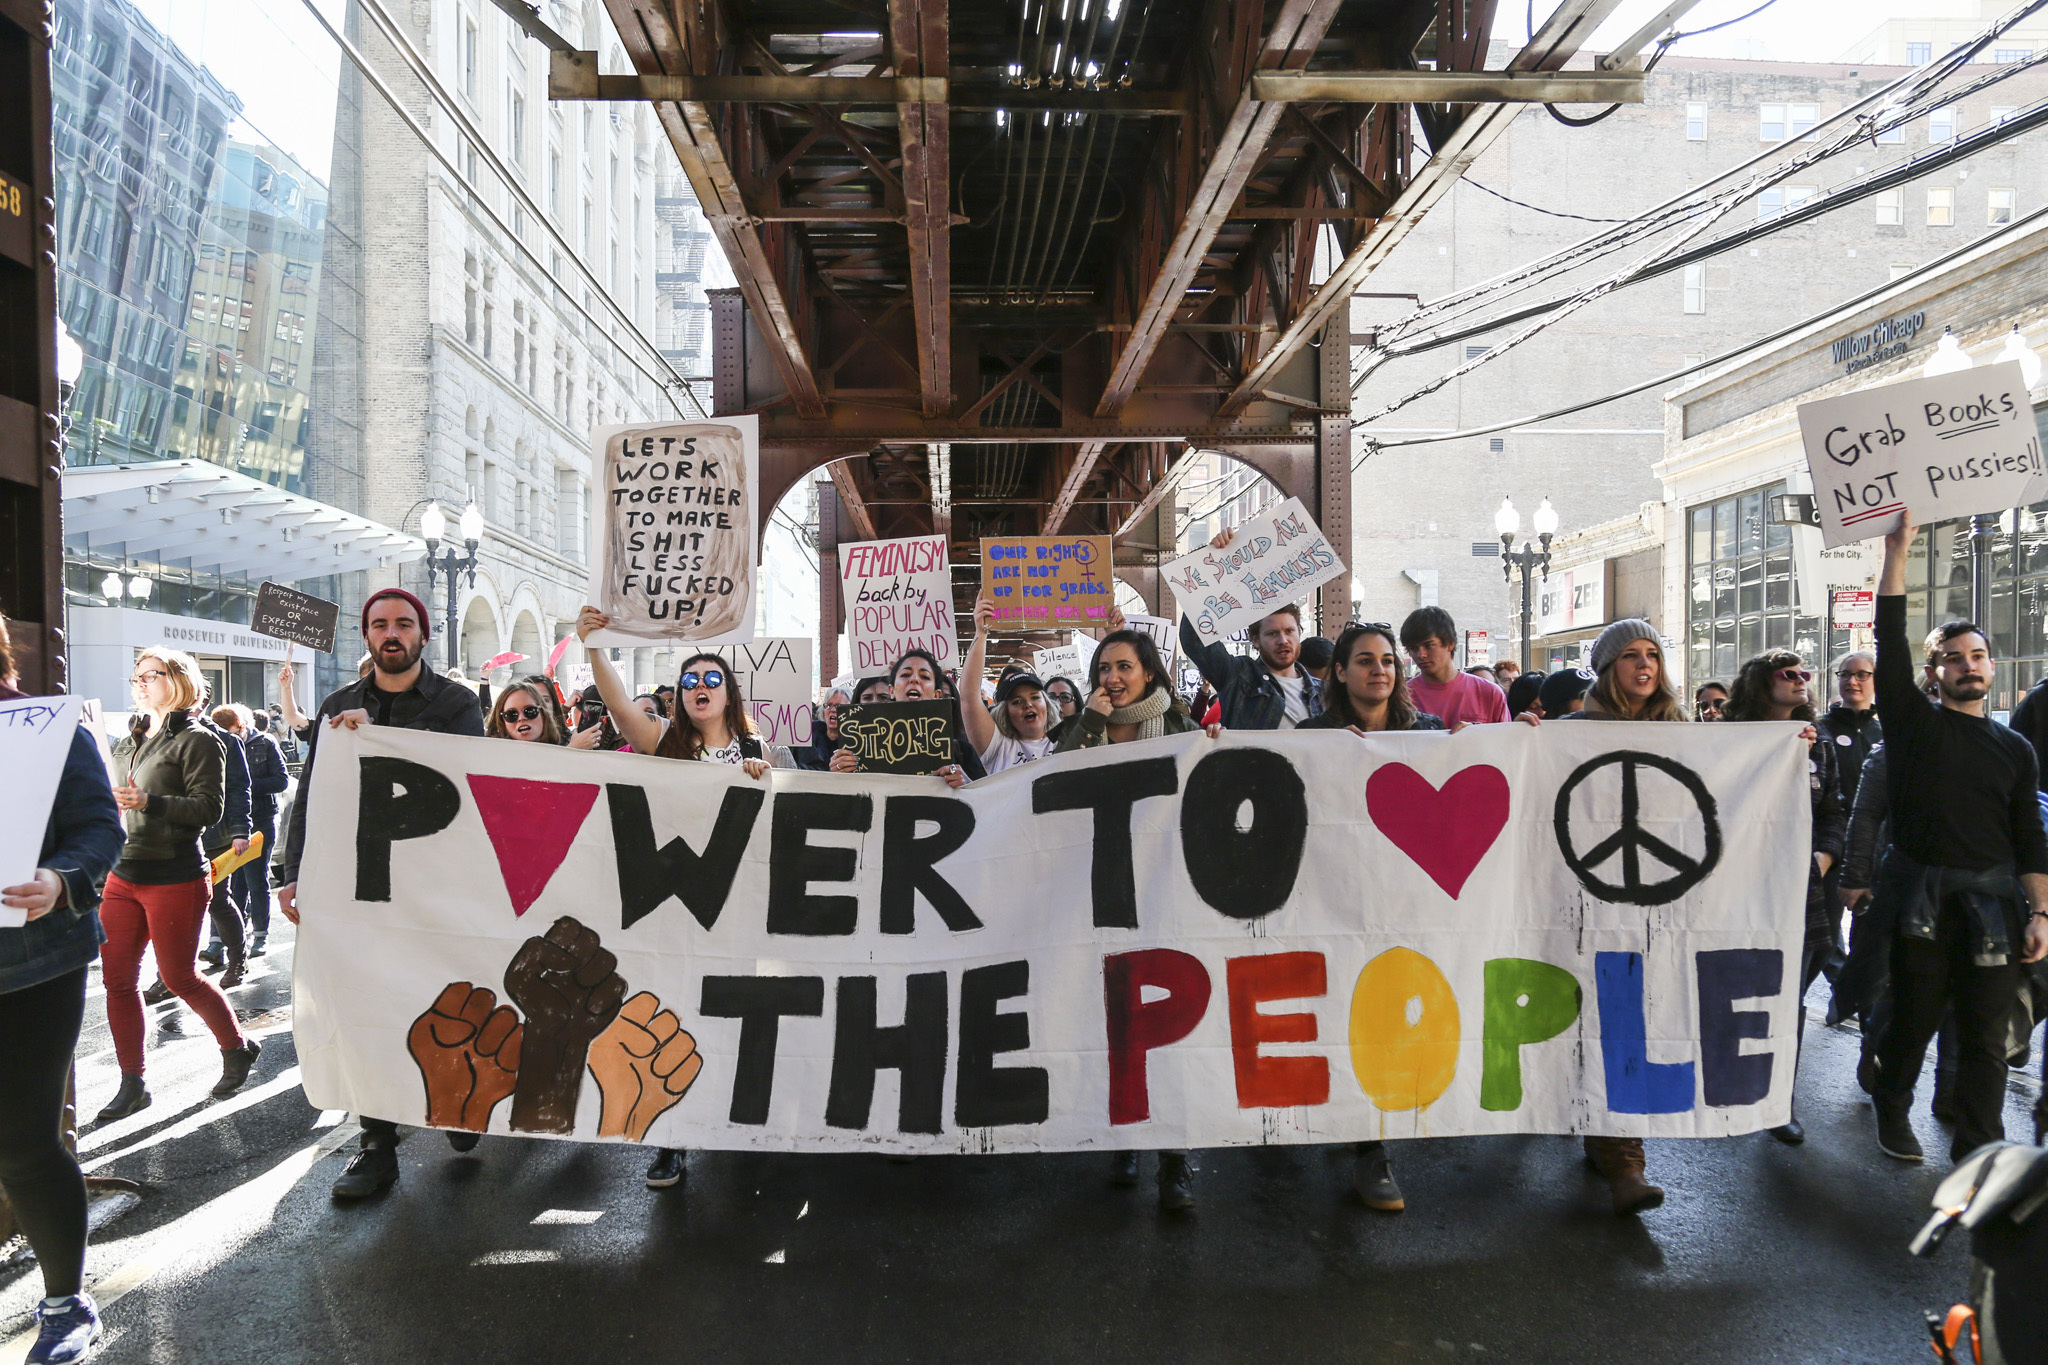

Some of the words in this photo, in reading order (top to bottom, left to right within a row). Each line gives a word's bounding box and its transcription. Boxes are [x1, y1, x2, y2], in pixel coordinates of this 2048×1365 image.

[1832, 334, 1870, 364] Willow
[1873, 312, 1924, 347] Chicago
[1825, 412, 1906, 467] Grab
[1924, 392, 2018, 427] Books,
[622, 437, 697, 458] LETS
[616, 460, 719, 483] WORK
[612, 486, 741, 507] TOGETHER
[1833, 471, 1898, 514] NOT
[626, 511, 655, 528] TO
[667, 511, 732, 530] MAKE
[627, 531, 705, 552] SHIT
[989, 545, 1028, 560] OUR
[1203, 537, 1271, 584] SHOULD
[1272, 511, 1307, 546] ALL
[631, 554, 704, 573] LESS
[844, 540, 945, 579] FEMINISM
[1820, 550, 1832, 559] For
[1834, 550, 1845, 559] the
[1846, 550, 1862, 560] City.
[992, 566, 1021, 579] ARE
[1027, 565, 1060, 578] NOT
[1204, 591, 1243, 620] BE
[1240, 538, 1334, 604] FEMINISTS
[622, 574, 734, 596] FUCKED
[856, 575, 900, 604] back
[903, 576, 927, 607] by
[993, 586, 1013, 597] UP
[1022, 585, 1053, 597] FOR
[280, 599, 320, 617] existence
[287, 611, 301, 621] OR
[649, 598, 707, 626] UP!
[854, 600, 951, 637] POPULAR
[1054, 606, 1081, 618] ARE
[262, 614, 297, 629] EXPECT
[303, 625, 324, 636] MY
[164, 625, 226, 645] ROOSEVELT
[233, 634, 289, 651] UNIVERSITY
[268, 626, 327, 648] RESISTANCE!
[858, 633, 949, 669] DEMAND
[1040, 650, 1077, 665] Silence
[838, 712, 847, 722] I
[849, 705, 863, 717] AM
[839, 717, 952, 765] STRONG
[1031, 746, 1308, 929] TO
[699, 960, 1050, 1135] THE
[1102, 944, 1784, 1127] PEOPLE
